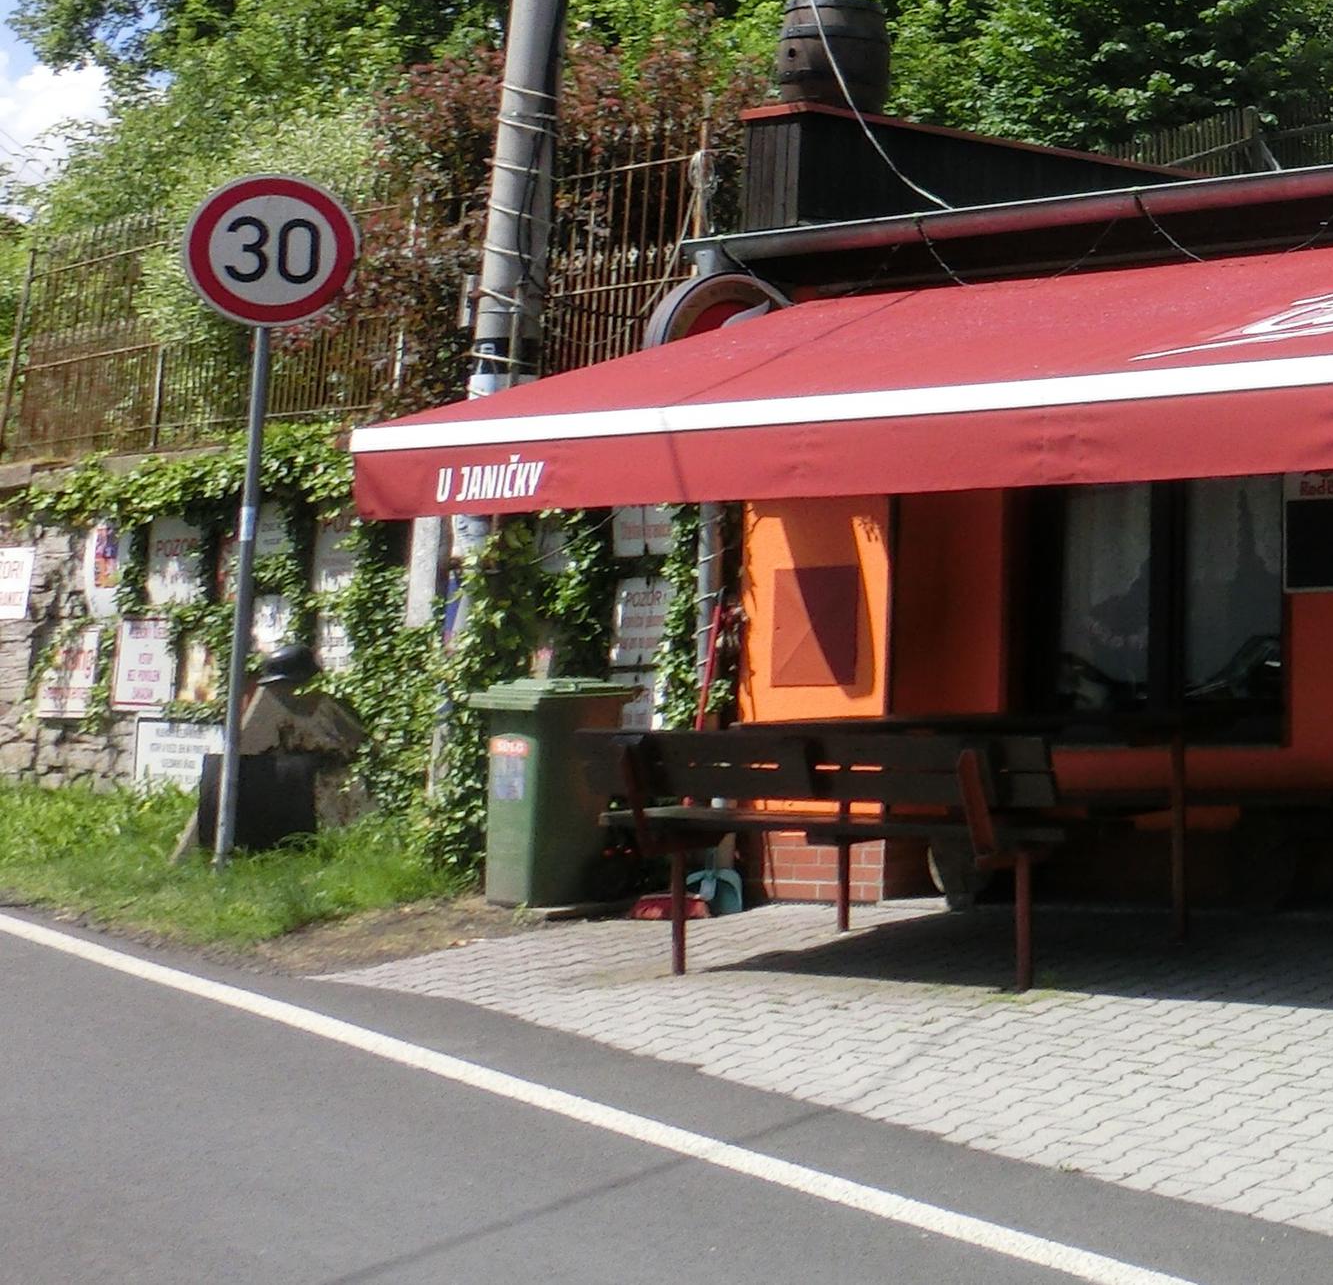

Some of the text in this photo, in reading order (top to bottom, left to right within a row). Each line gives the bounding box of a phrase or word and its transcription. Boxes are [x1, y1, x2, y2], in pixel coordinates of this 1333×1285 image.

[223, 216, 322, 285] 30
[436, 453, 545, 503] U JANIČKY
[1300, 478, 1326, 496] Red
